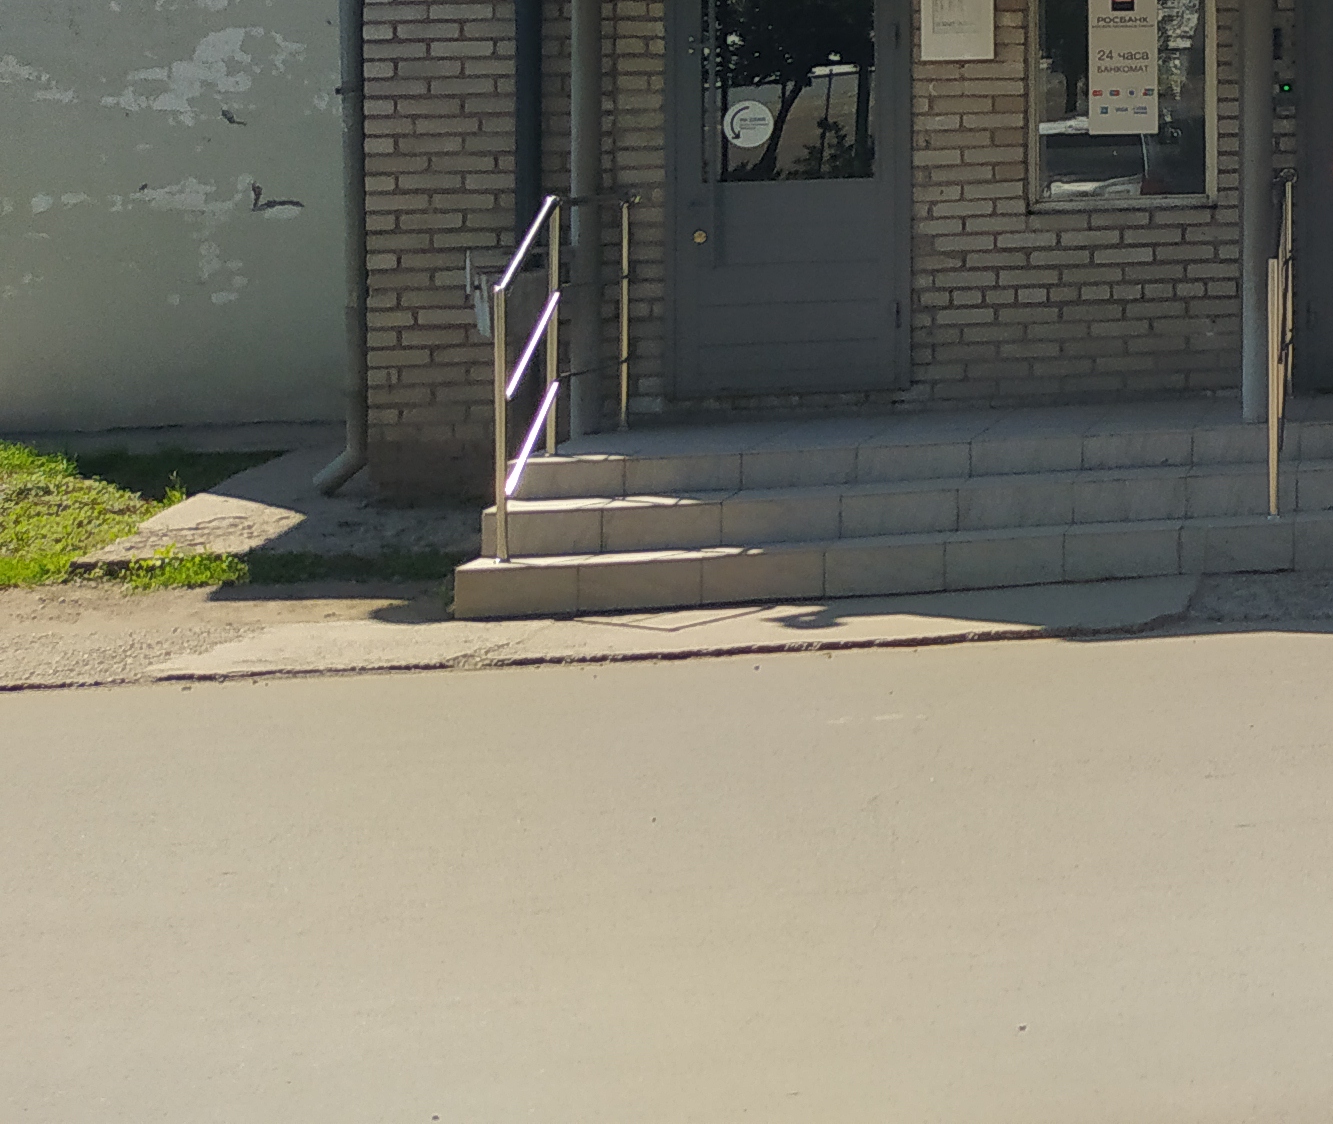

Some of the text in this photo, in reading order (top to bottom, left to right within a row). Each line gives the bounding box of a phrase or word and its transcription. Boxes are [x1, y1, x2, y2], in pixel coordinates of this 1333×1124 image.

[1096, 16, 1149, 24] РОСБАНК
[1097, 49, 1150, 61] 24 часа
[1096, 64, 1150, 74] БАНКОМАТ
